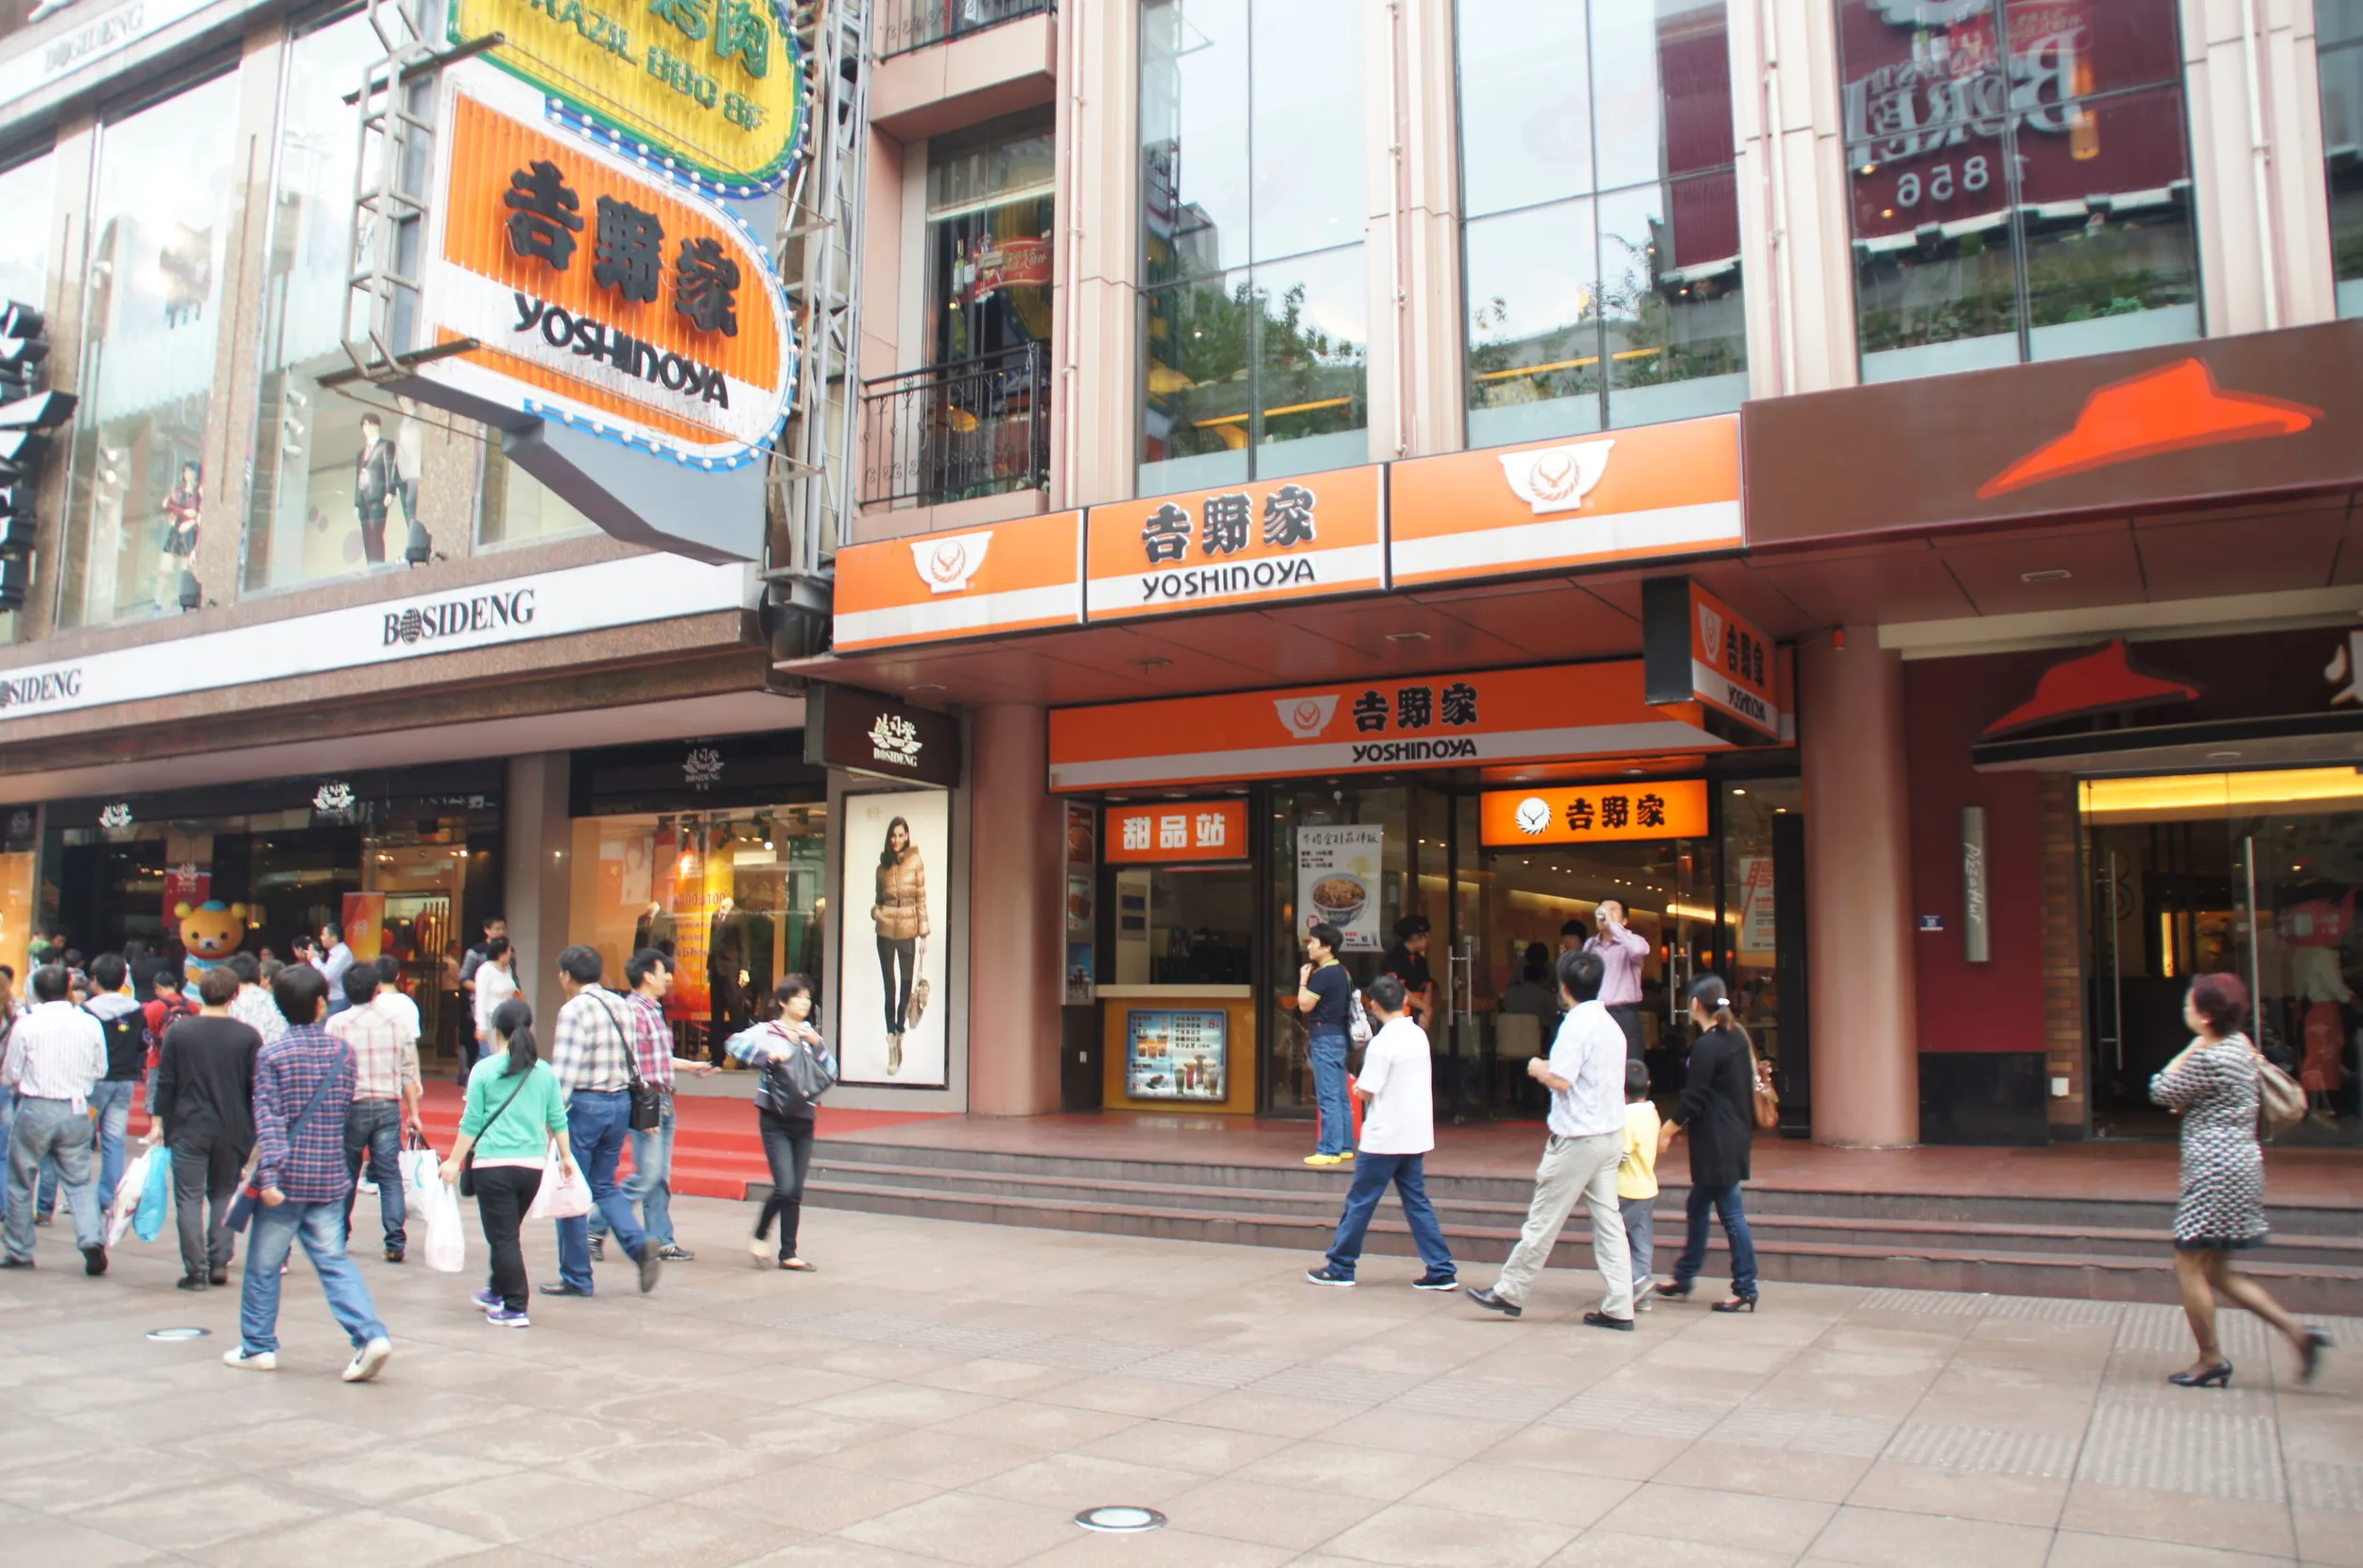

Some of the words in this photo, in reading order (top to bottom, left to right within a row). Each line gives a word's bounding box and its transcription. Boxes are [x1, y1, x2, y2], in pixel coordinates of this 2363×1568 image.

[504, 160, 740, 337] 吉野家
[513, 291, 729, 409] YOSHINOYA
[1142, 483, 1317, 565] 吉野家
[1142, 558, 1316, 602] YOSHINOYA
[1727, 623, 1766, 689] 吉野家
[1352, 681, 1479, 733] 吉野家
[1352, 738, 1477, 764] YOSHINOYA
[1123, 813, 1226, 851] 甜品站
[1565, 793, 1666, 831] 吉野家
